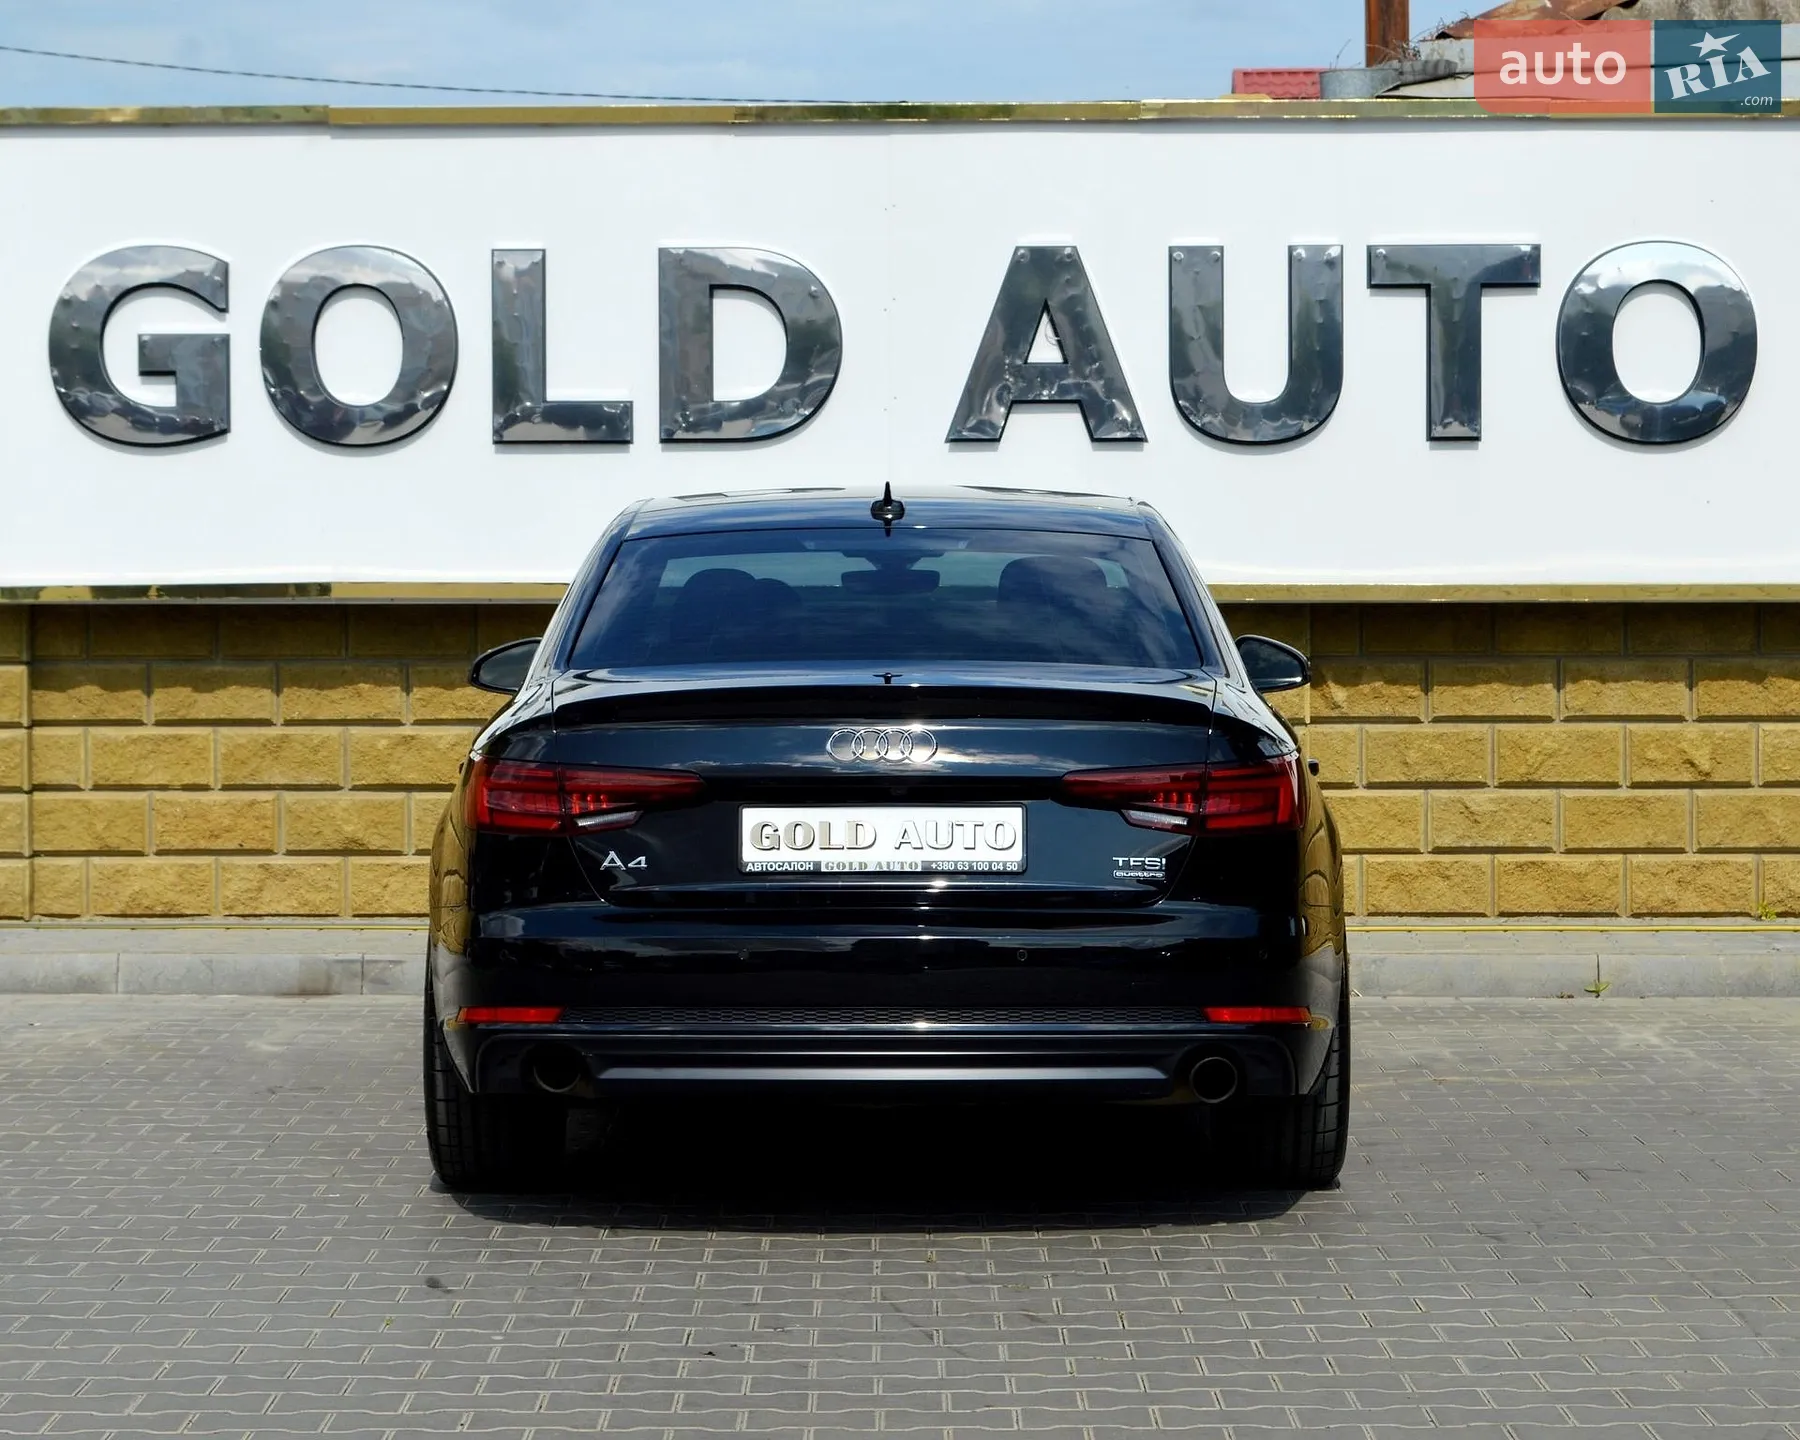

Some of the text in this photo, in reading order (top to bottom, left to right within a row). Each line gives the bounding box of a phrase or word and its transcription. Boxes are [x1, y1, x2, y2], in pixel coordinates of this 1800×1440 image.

[48, 241, 1758, 446] GOLD AUTO
[750, 820, 1017, 851] GOLD AUTO
[600, 850, 648, 871] A4
[746, 861, 1018, 872] АВТОСАЛОН GOLD AUTO +380 63 100 04 50
[1112, 856, 1166, 870] TFSI
